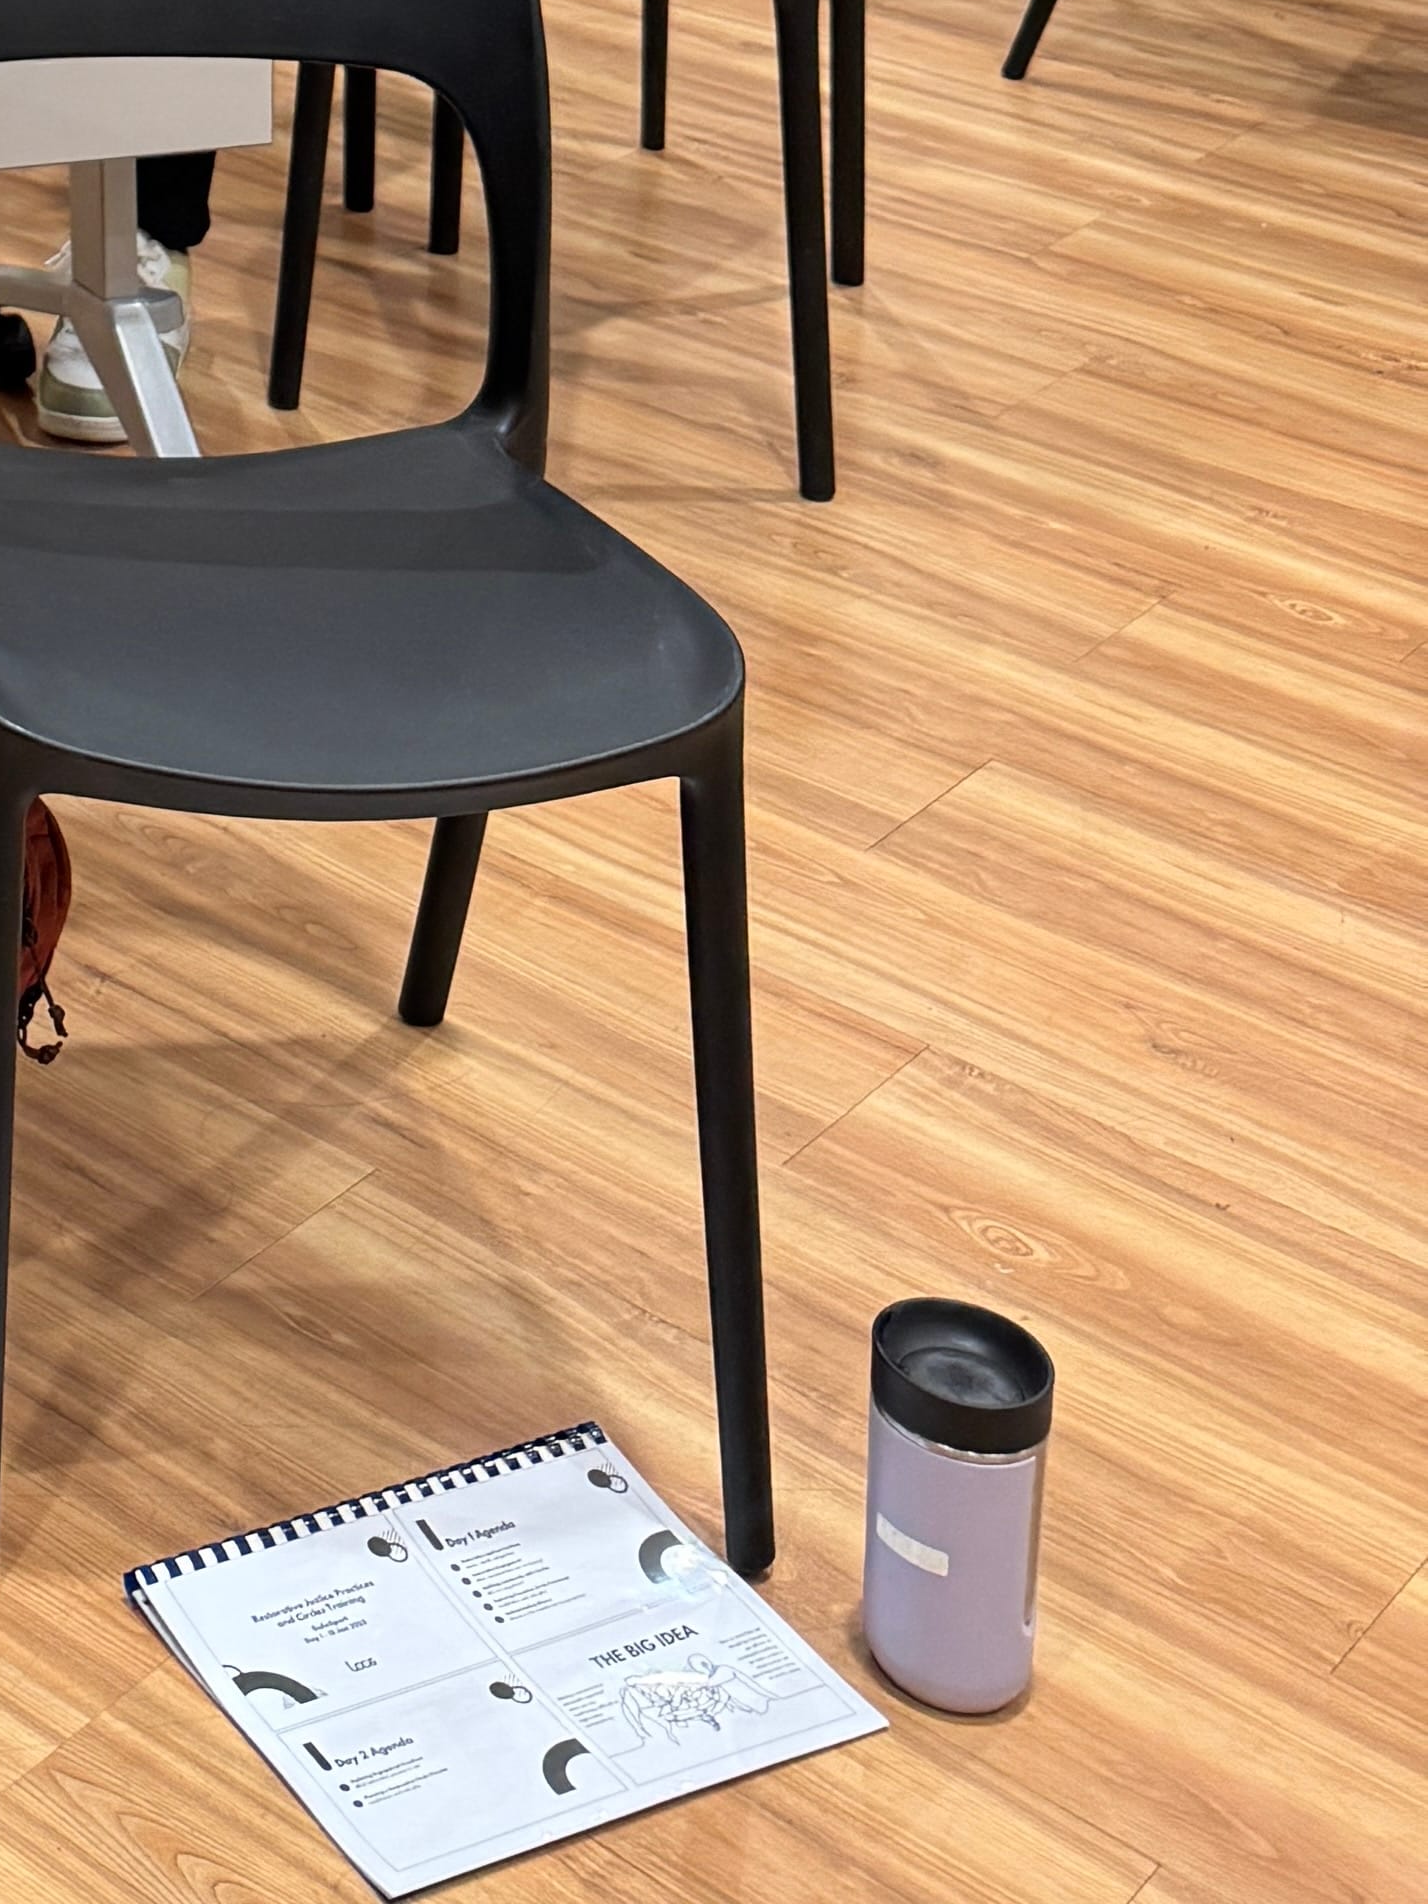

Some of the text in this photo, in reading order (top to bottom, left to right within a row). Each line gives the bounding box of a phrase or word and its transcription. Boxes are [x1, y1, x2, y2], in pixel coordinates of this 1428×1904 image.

[445, 1536, 469, 1548] Day
[474, 1520, 517, 1539] Agenda
[251, 1580, 375, 1624] Restorative Justice Practices
[277, 1595, 366, 1628] and Circles Training
[588, 1624, 700, 1670] THE BIG IDEA
[334, 1737, 414, 1767] Day 2 Agenda
